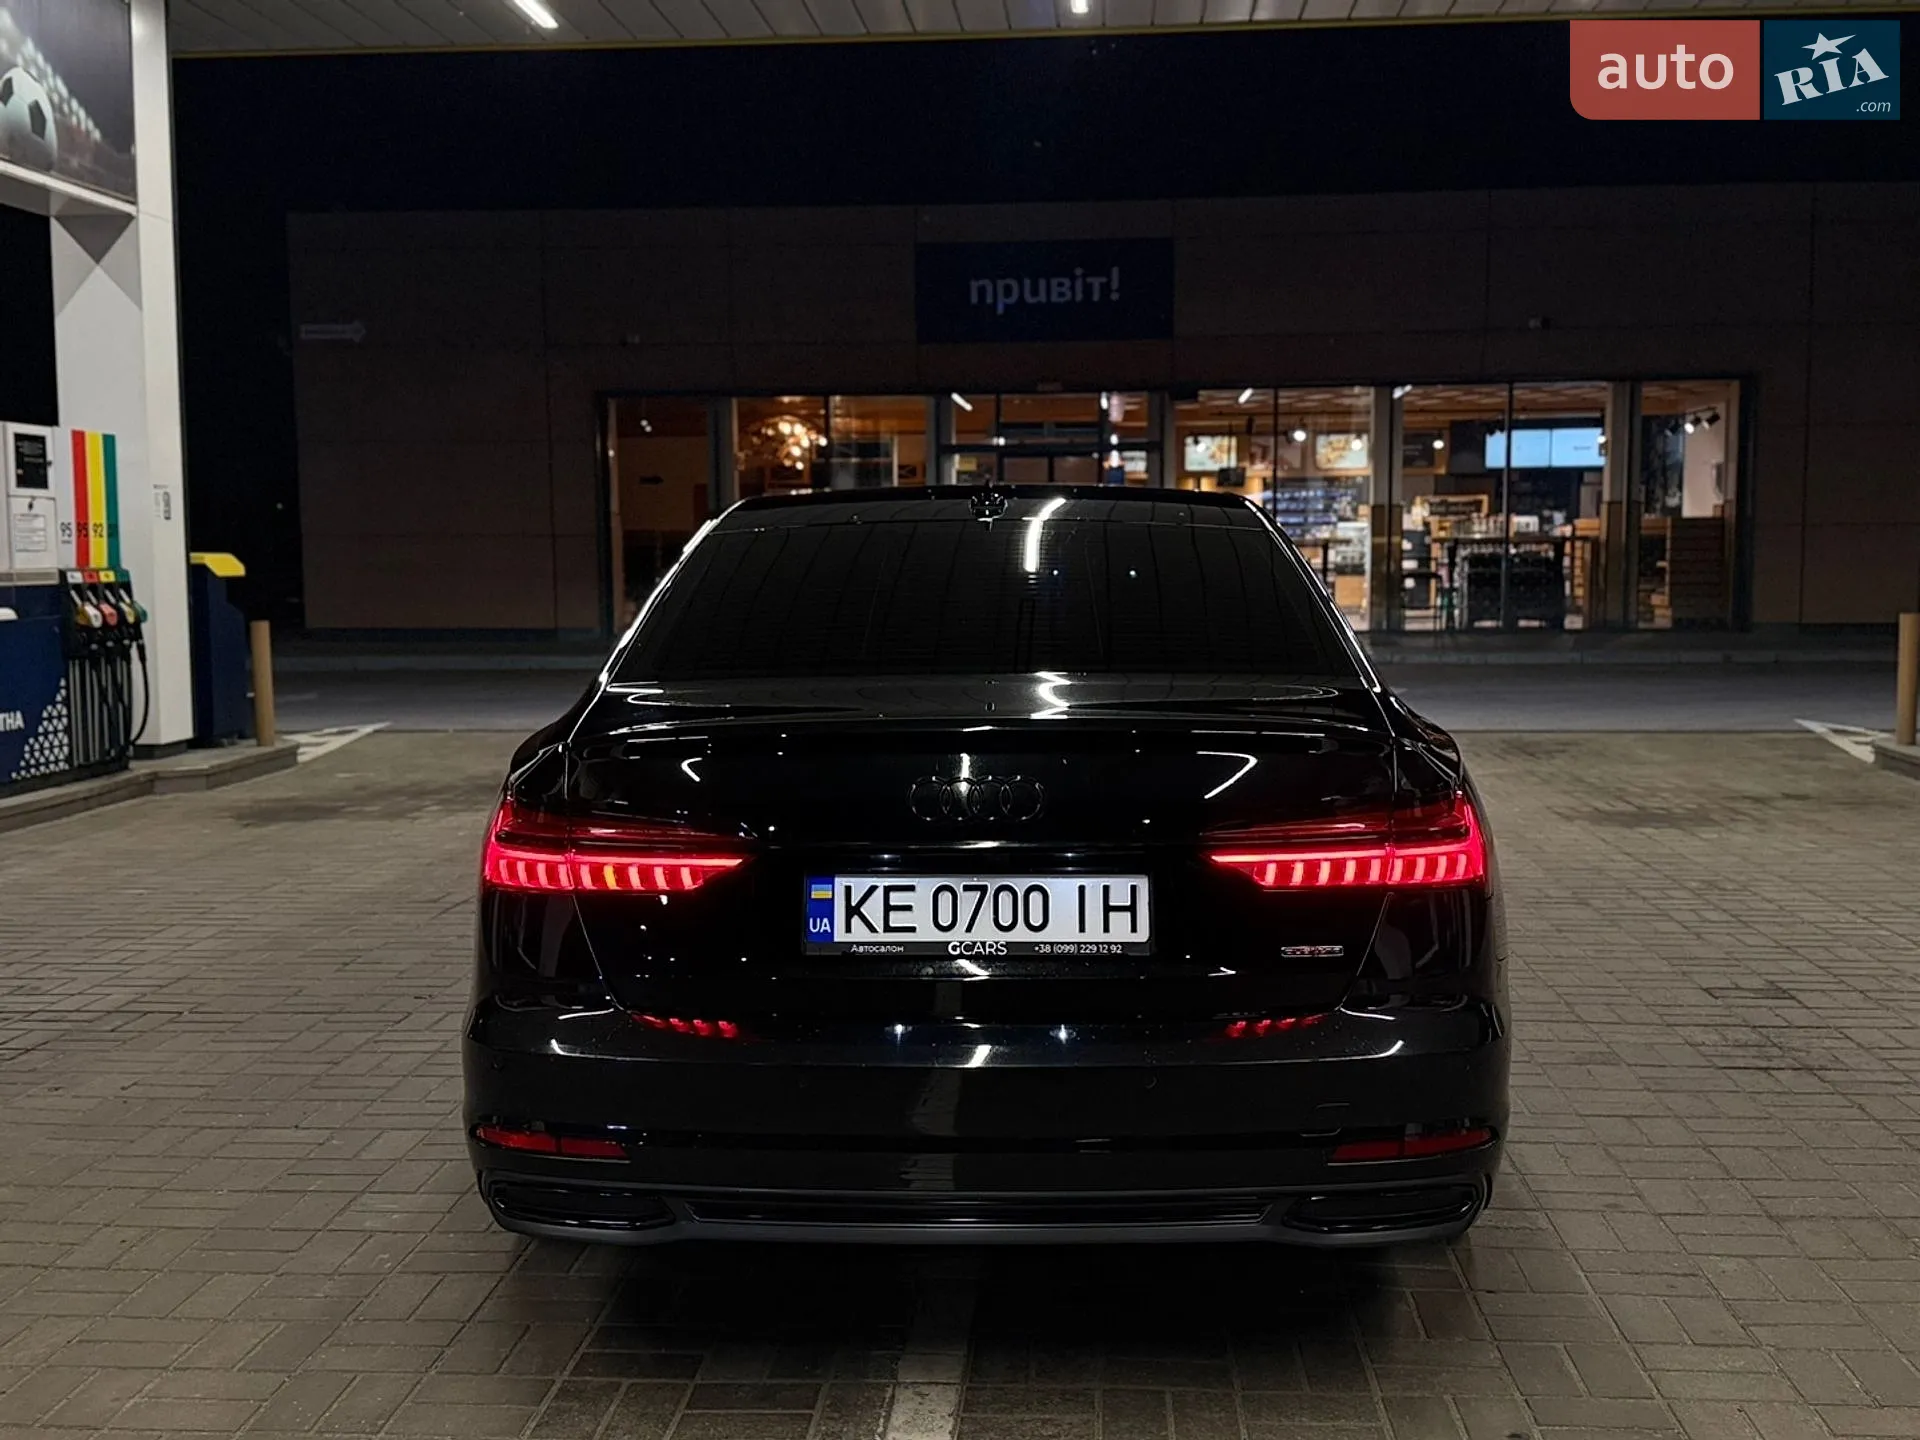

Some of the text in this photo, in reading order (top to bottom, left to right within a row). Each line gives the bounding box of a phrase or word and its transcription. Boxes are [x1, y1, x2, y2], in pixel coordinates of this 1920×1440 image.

[970, 266, 1121, 315] привіт!
[61, 522, 72, 538] 95
[92, 523, 104, 538] 92
[845, 884, 917, 933] KE
[932, 884, 1050, 933] 0700
[809, 917, 831, 932] UA
[850, 944, 904, 953] Автосалон
[947, 941, 1007, 955] GCARS
[1034, 944, 1122, 954] +38 (099) 229 12 92
